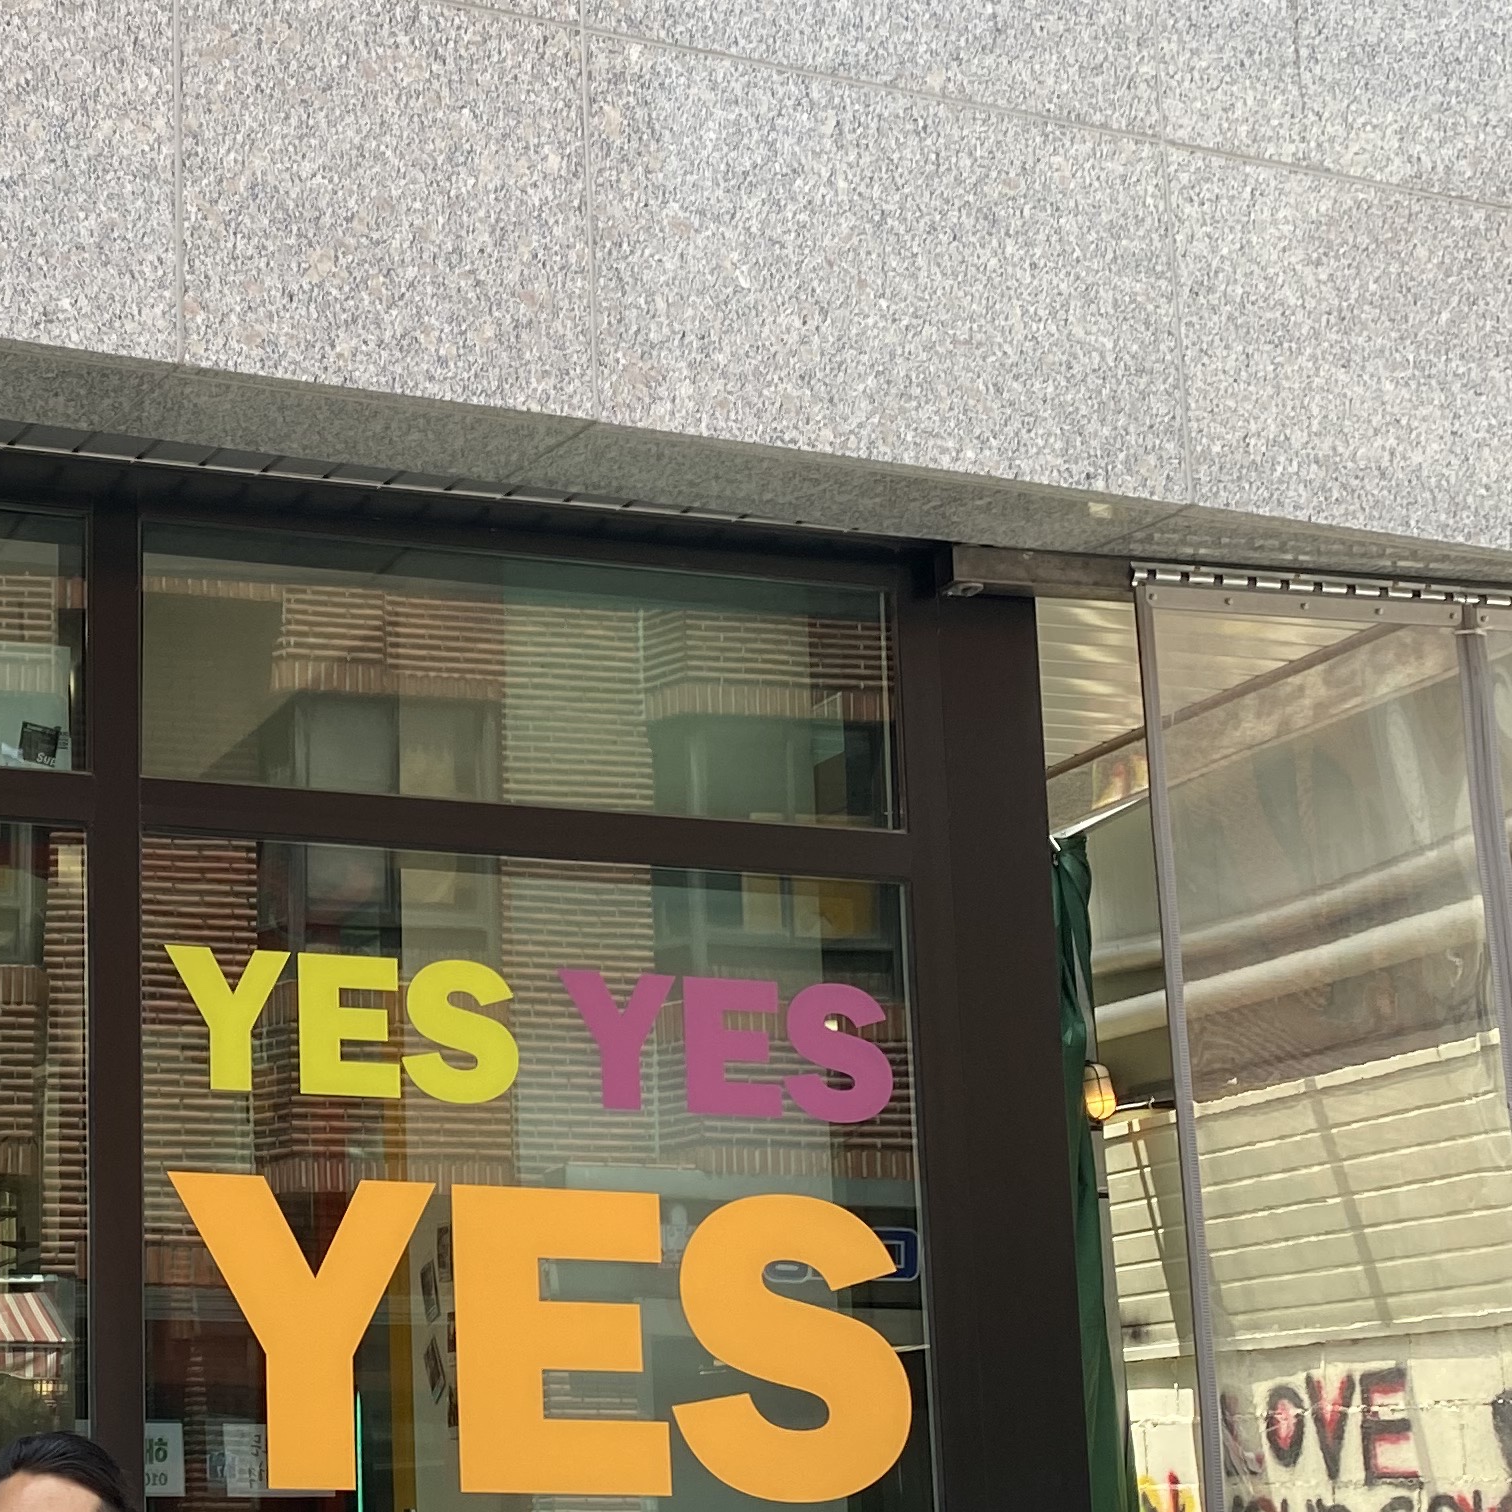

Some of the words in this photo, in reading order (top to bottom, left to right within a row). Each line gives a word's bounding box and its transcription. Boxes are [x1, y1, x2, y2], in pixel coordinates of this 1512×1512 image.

[167, 944, 519, 1104] YES
[560, 966, 897, 1124] YES
[167, 1171, 912, 1503] YES
